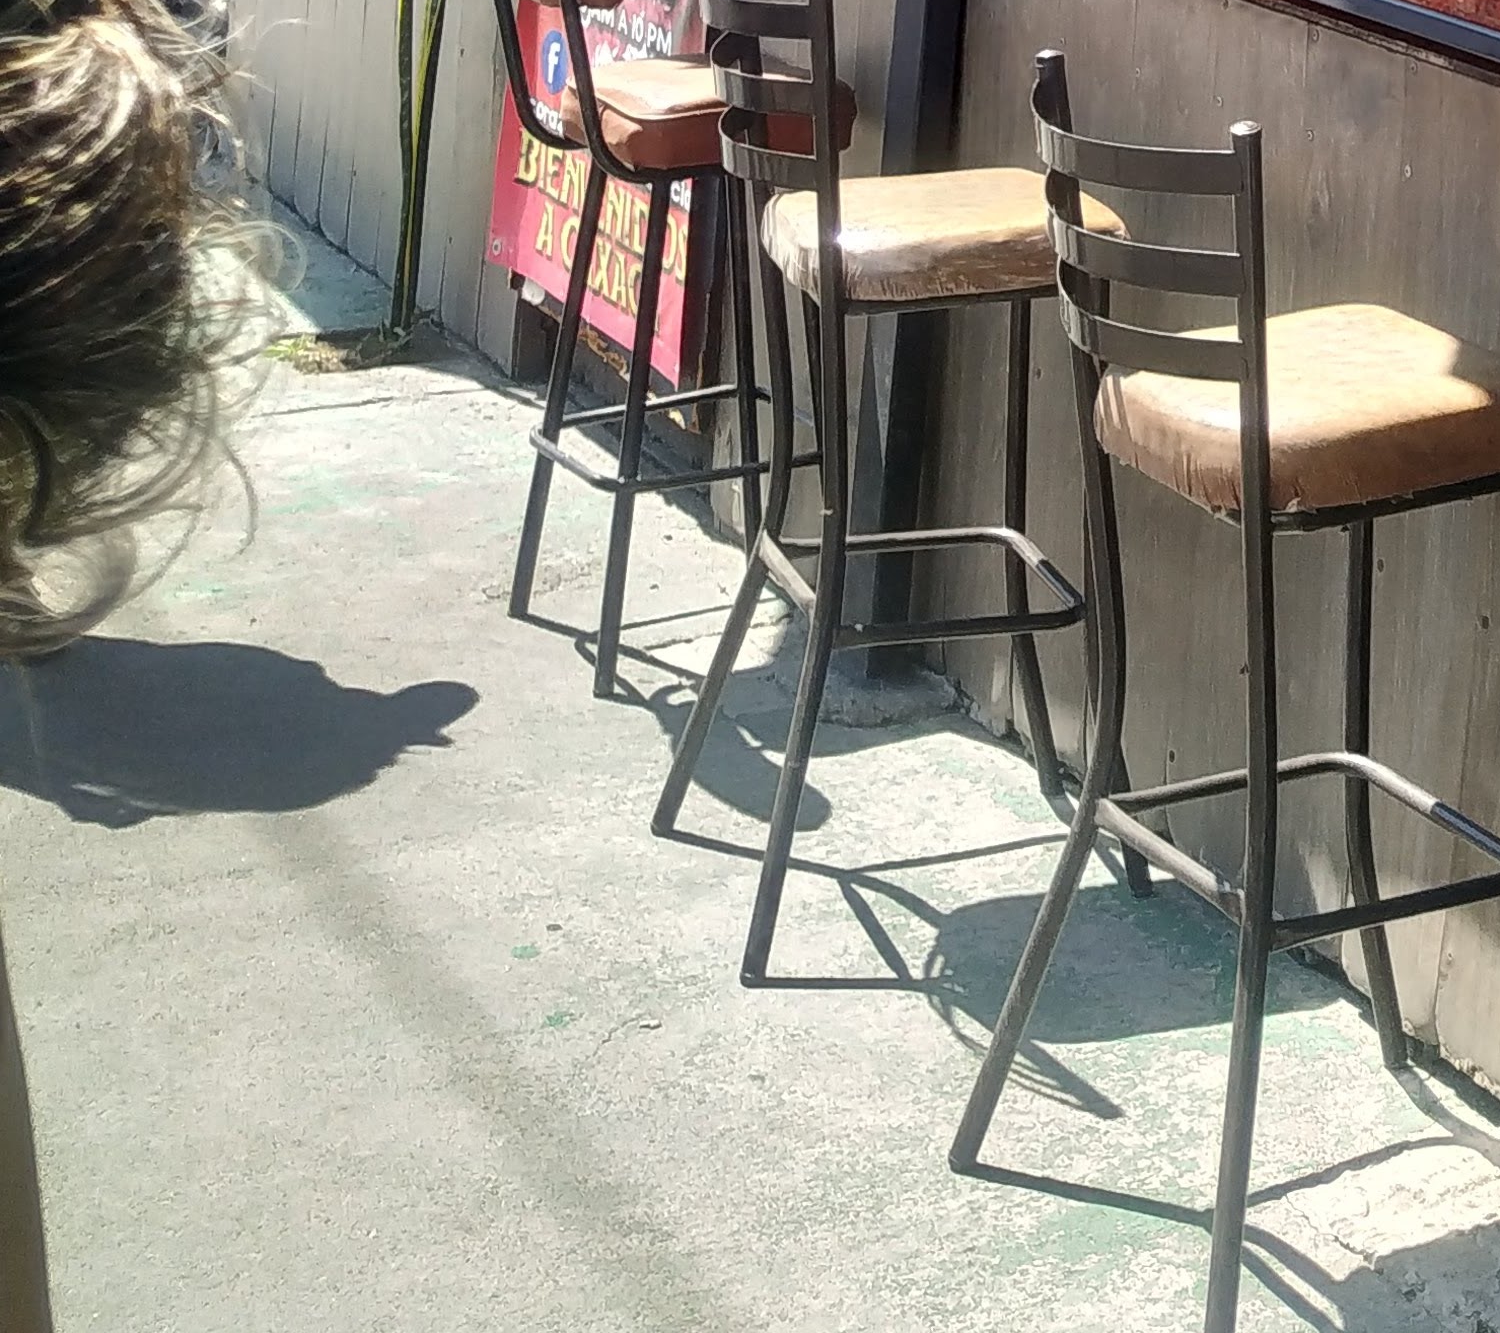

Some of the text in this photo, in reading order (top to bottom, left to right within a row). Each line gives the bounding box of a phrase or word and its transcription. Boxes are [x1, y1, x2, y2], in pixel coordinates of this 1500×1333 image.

[618, 9, 628, 36] A
[631, 13, 644, 43] 10
[647, 21, 672, 57] PM
[536, 201, 554, 257] A
